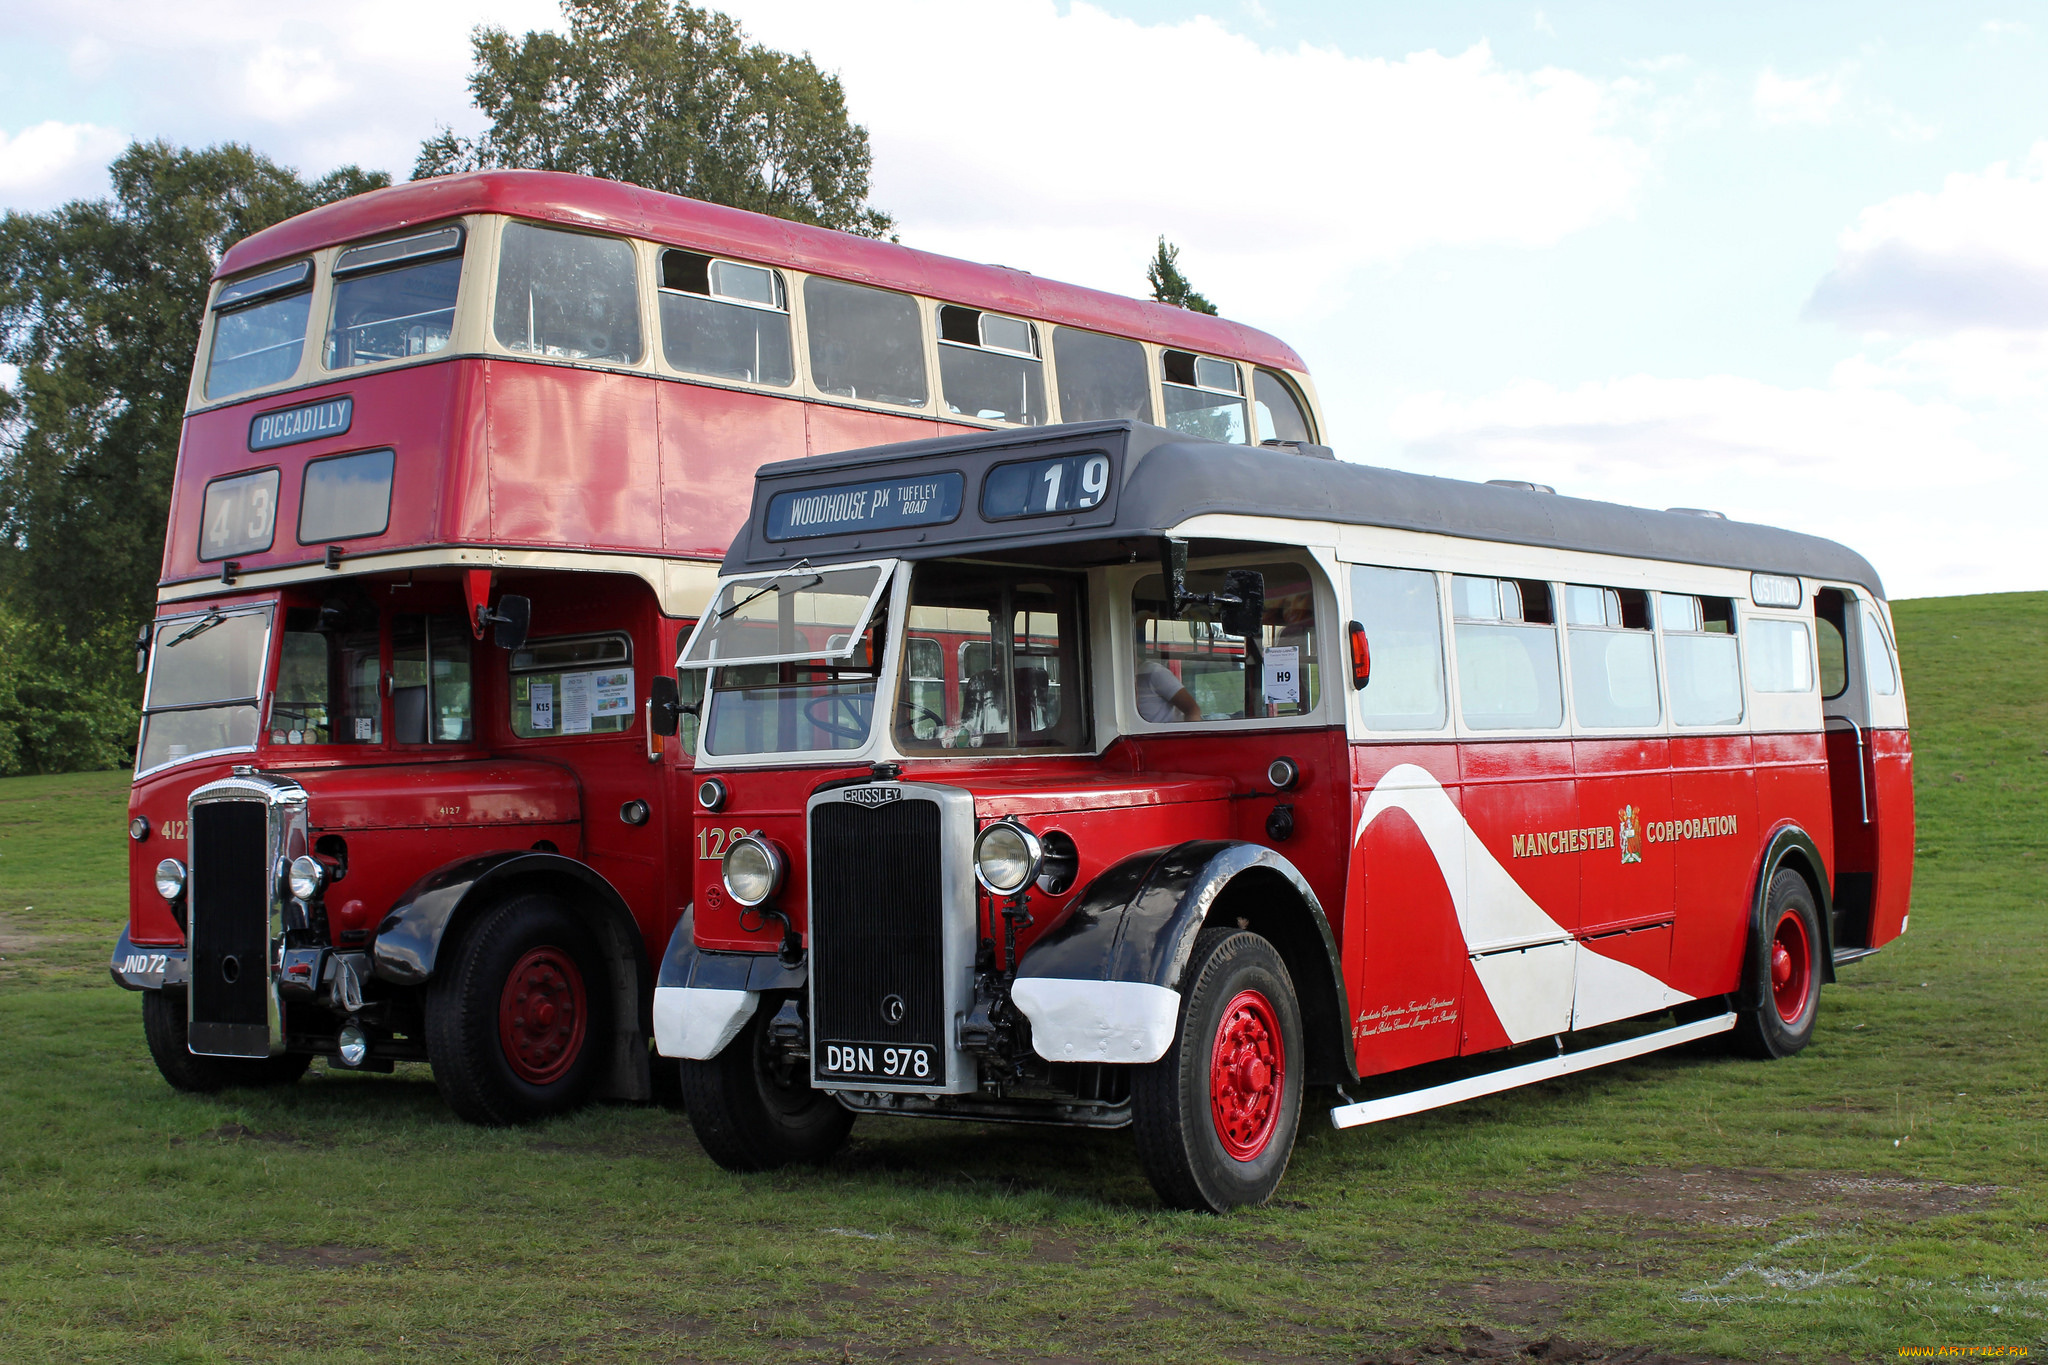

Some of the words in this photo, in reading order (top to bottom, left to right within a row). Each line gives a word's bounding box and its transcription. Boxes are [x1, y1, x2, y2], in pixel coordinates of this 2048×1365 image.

[259, 401, 347, 441] PICCADILLY
[897, 483, 938, 502] TUFFLEY
[1043, 454, 1110, 512] 19
[790, 491, 868, 526] WOODHOUSE
[902, 499, 928, 515] ROAD
[1276, 671, 1291, 682] H9
[536, 702, 550, 712] K15
[844, 788, 899, 803] CROSSLEY
[440, 806, 460, 815] 4127
[1511, 826, 1615, 858] MANCHESTER
[1646, 815, 1738, 843] CORPORATION
[119, 954, 148, 974] JND
[1406, 1001, 1428, 1015] Transport
[1428, 997, 1455, 1012] Department
[827, 1045, 874, 1072] DBN
[882, 1048, 930, 1077] 978
